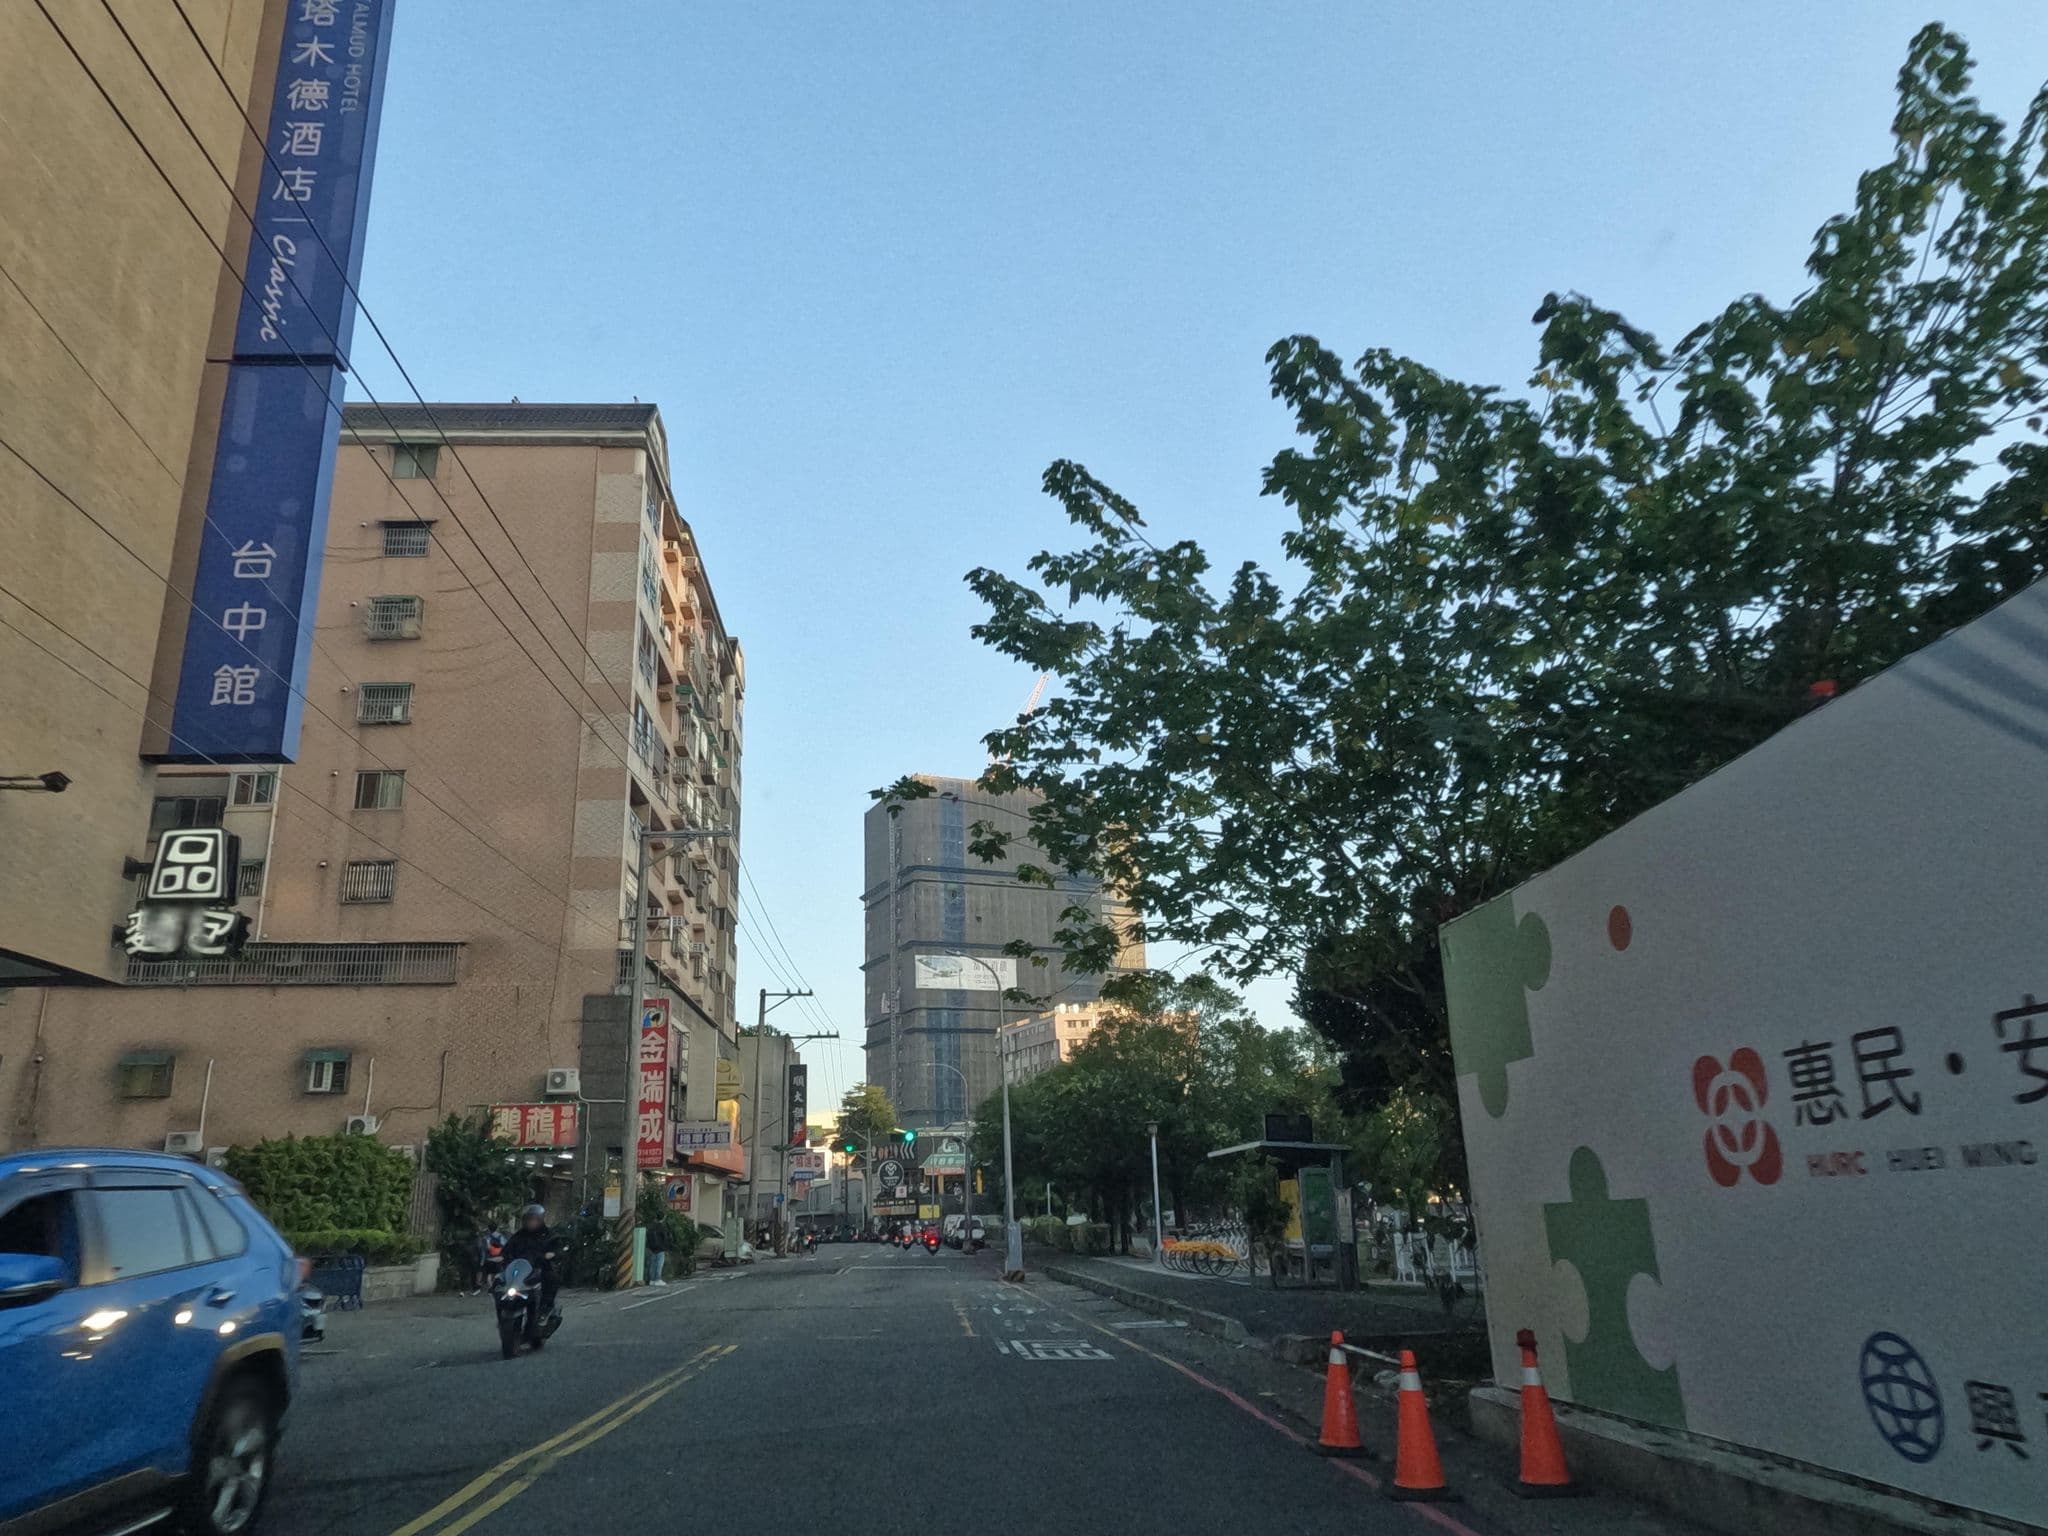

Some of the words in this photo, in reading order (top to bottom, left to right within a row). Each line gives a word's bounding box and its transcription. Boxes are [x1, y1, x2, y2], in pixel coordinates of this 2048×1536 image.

[348, 0, 371, 58] ALMUD
[340, 63, 362, 116] HOTEL
[259, 233, 298, 343] Classic
[209, 539, 278, 706] 台中館
